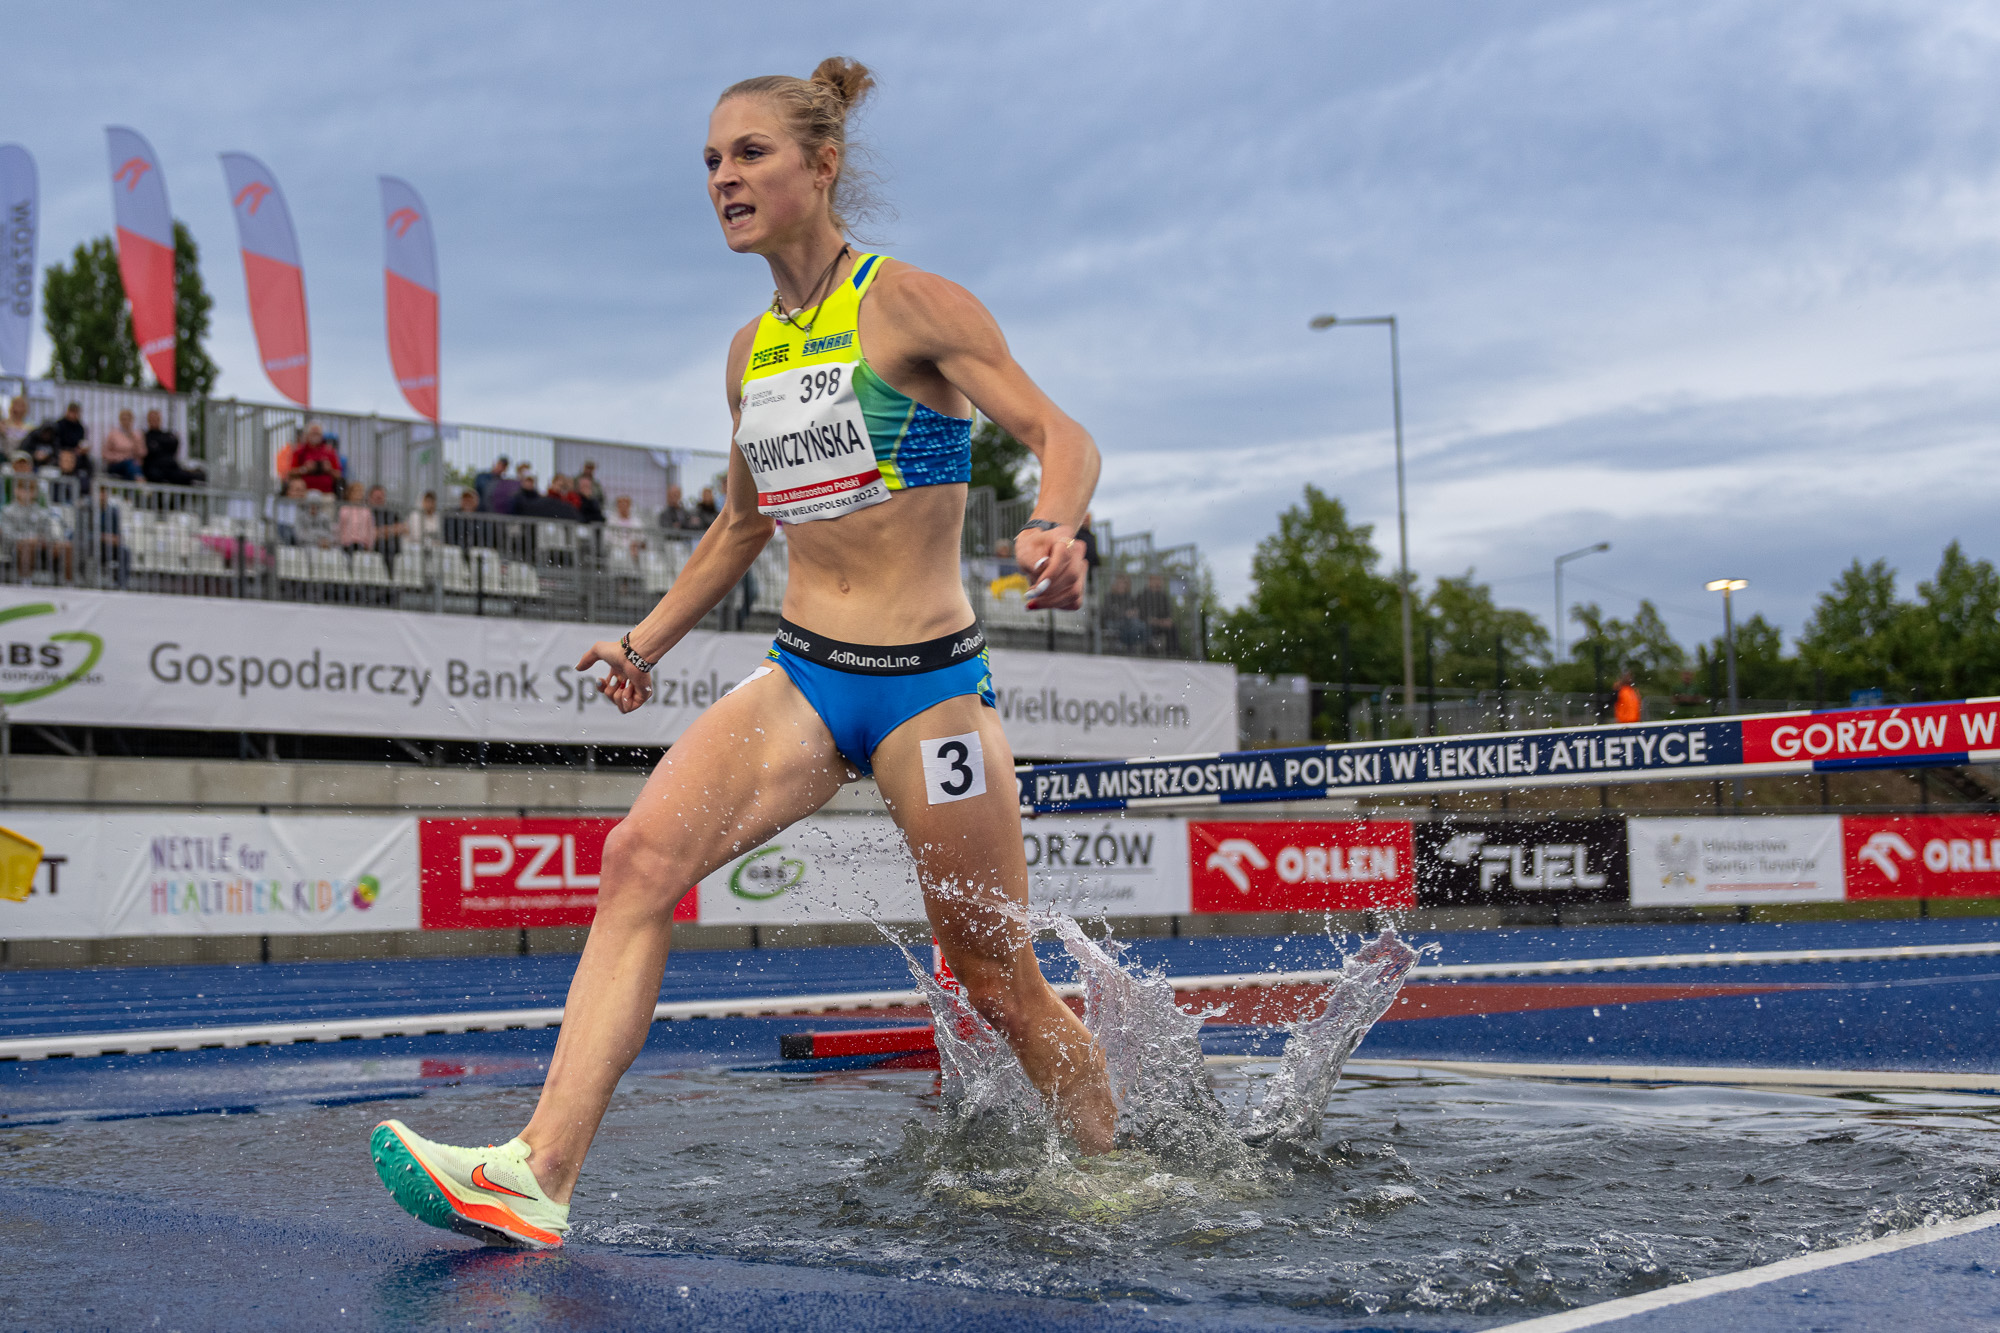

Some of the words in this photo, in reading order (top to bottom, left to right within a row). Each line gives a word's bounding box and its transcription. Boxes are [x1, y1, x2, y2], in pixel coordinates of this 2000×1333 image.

[800, 367, 841, 404] 398
[740, 420, 865, 474] KRAWCZYŃSKA
[789, 485, 834, 500] Mistrzostwa
[833, 477, 861, 491] Polski
[790, 496, 852, 517] WIELKOPOLSKI
[852, 486, 880, 503] 2023
[0, 643, 63, 668] BS
[149, 641, 432, 707] Gospodarczy
[447, 658, 542, 701] Bank
[936, 740, 974, 796] 3
[1036, 773, 1092, 801] PZLA
[1098, 761, 1278, 798] MISTRZOSTWA
[1285, 753, 1381, 787] POLSKI
[1389, 751, 1417, 780] W
[1426, 742, 1539, 779] LEKKIEJ
[1548, 731, 1708, 772] ATLETYCE
[1770, 708, 1948, 758] GORZÓW
[1960, 711, 1998, 746] W
[460, 834, 602, 891] PZL
[1023, 823, 1155, 867] ORZÓW
[1275, 845, 1397, 884] ORLEN
[1480, 843, 1608, 891] FUEL
[151, 878, 285, 916] HEALTHIER
